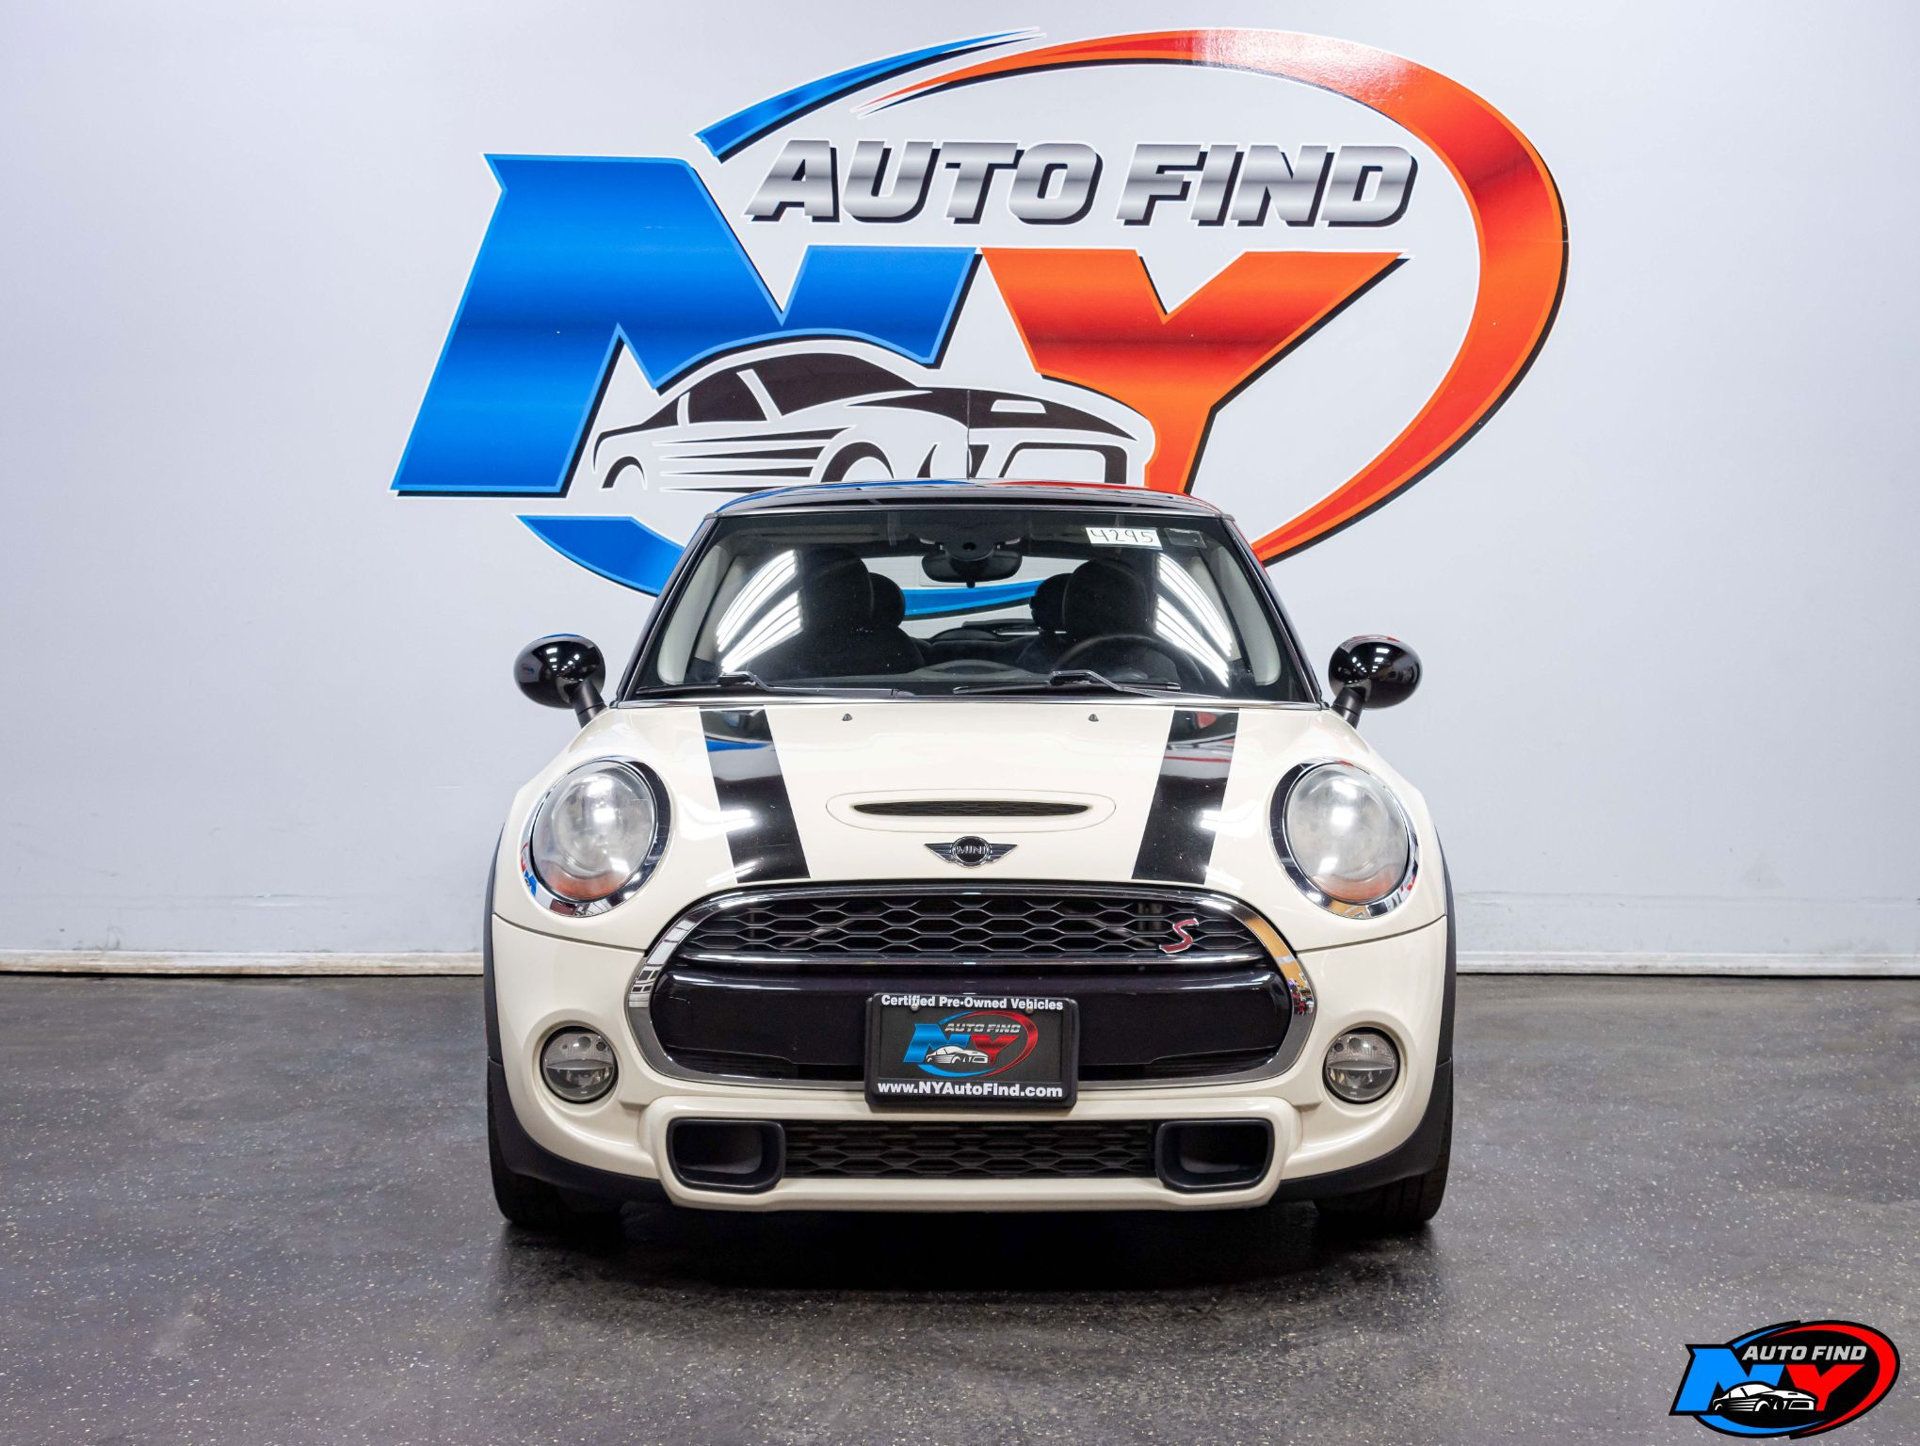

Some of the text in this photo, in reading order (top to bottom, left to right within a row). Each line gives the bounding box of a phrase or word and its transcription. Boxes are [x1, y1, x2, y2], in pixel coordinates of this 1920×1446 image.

[746, 140, 1417, 228] AUTO FIND
[956, 845, 986, 854] MINI
[1158, 918, 1199, 954] S
[881, 994, 1063, 1010] Certified Pre-Owned Vehicles
[945, 1023, 1021, 1033] AUTO FIND
[877, 1082, 1063, 1097] www.NYAutoFind.com
